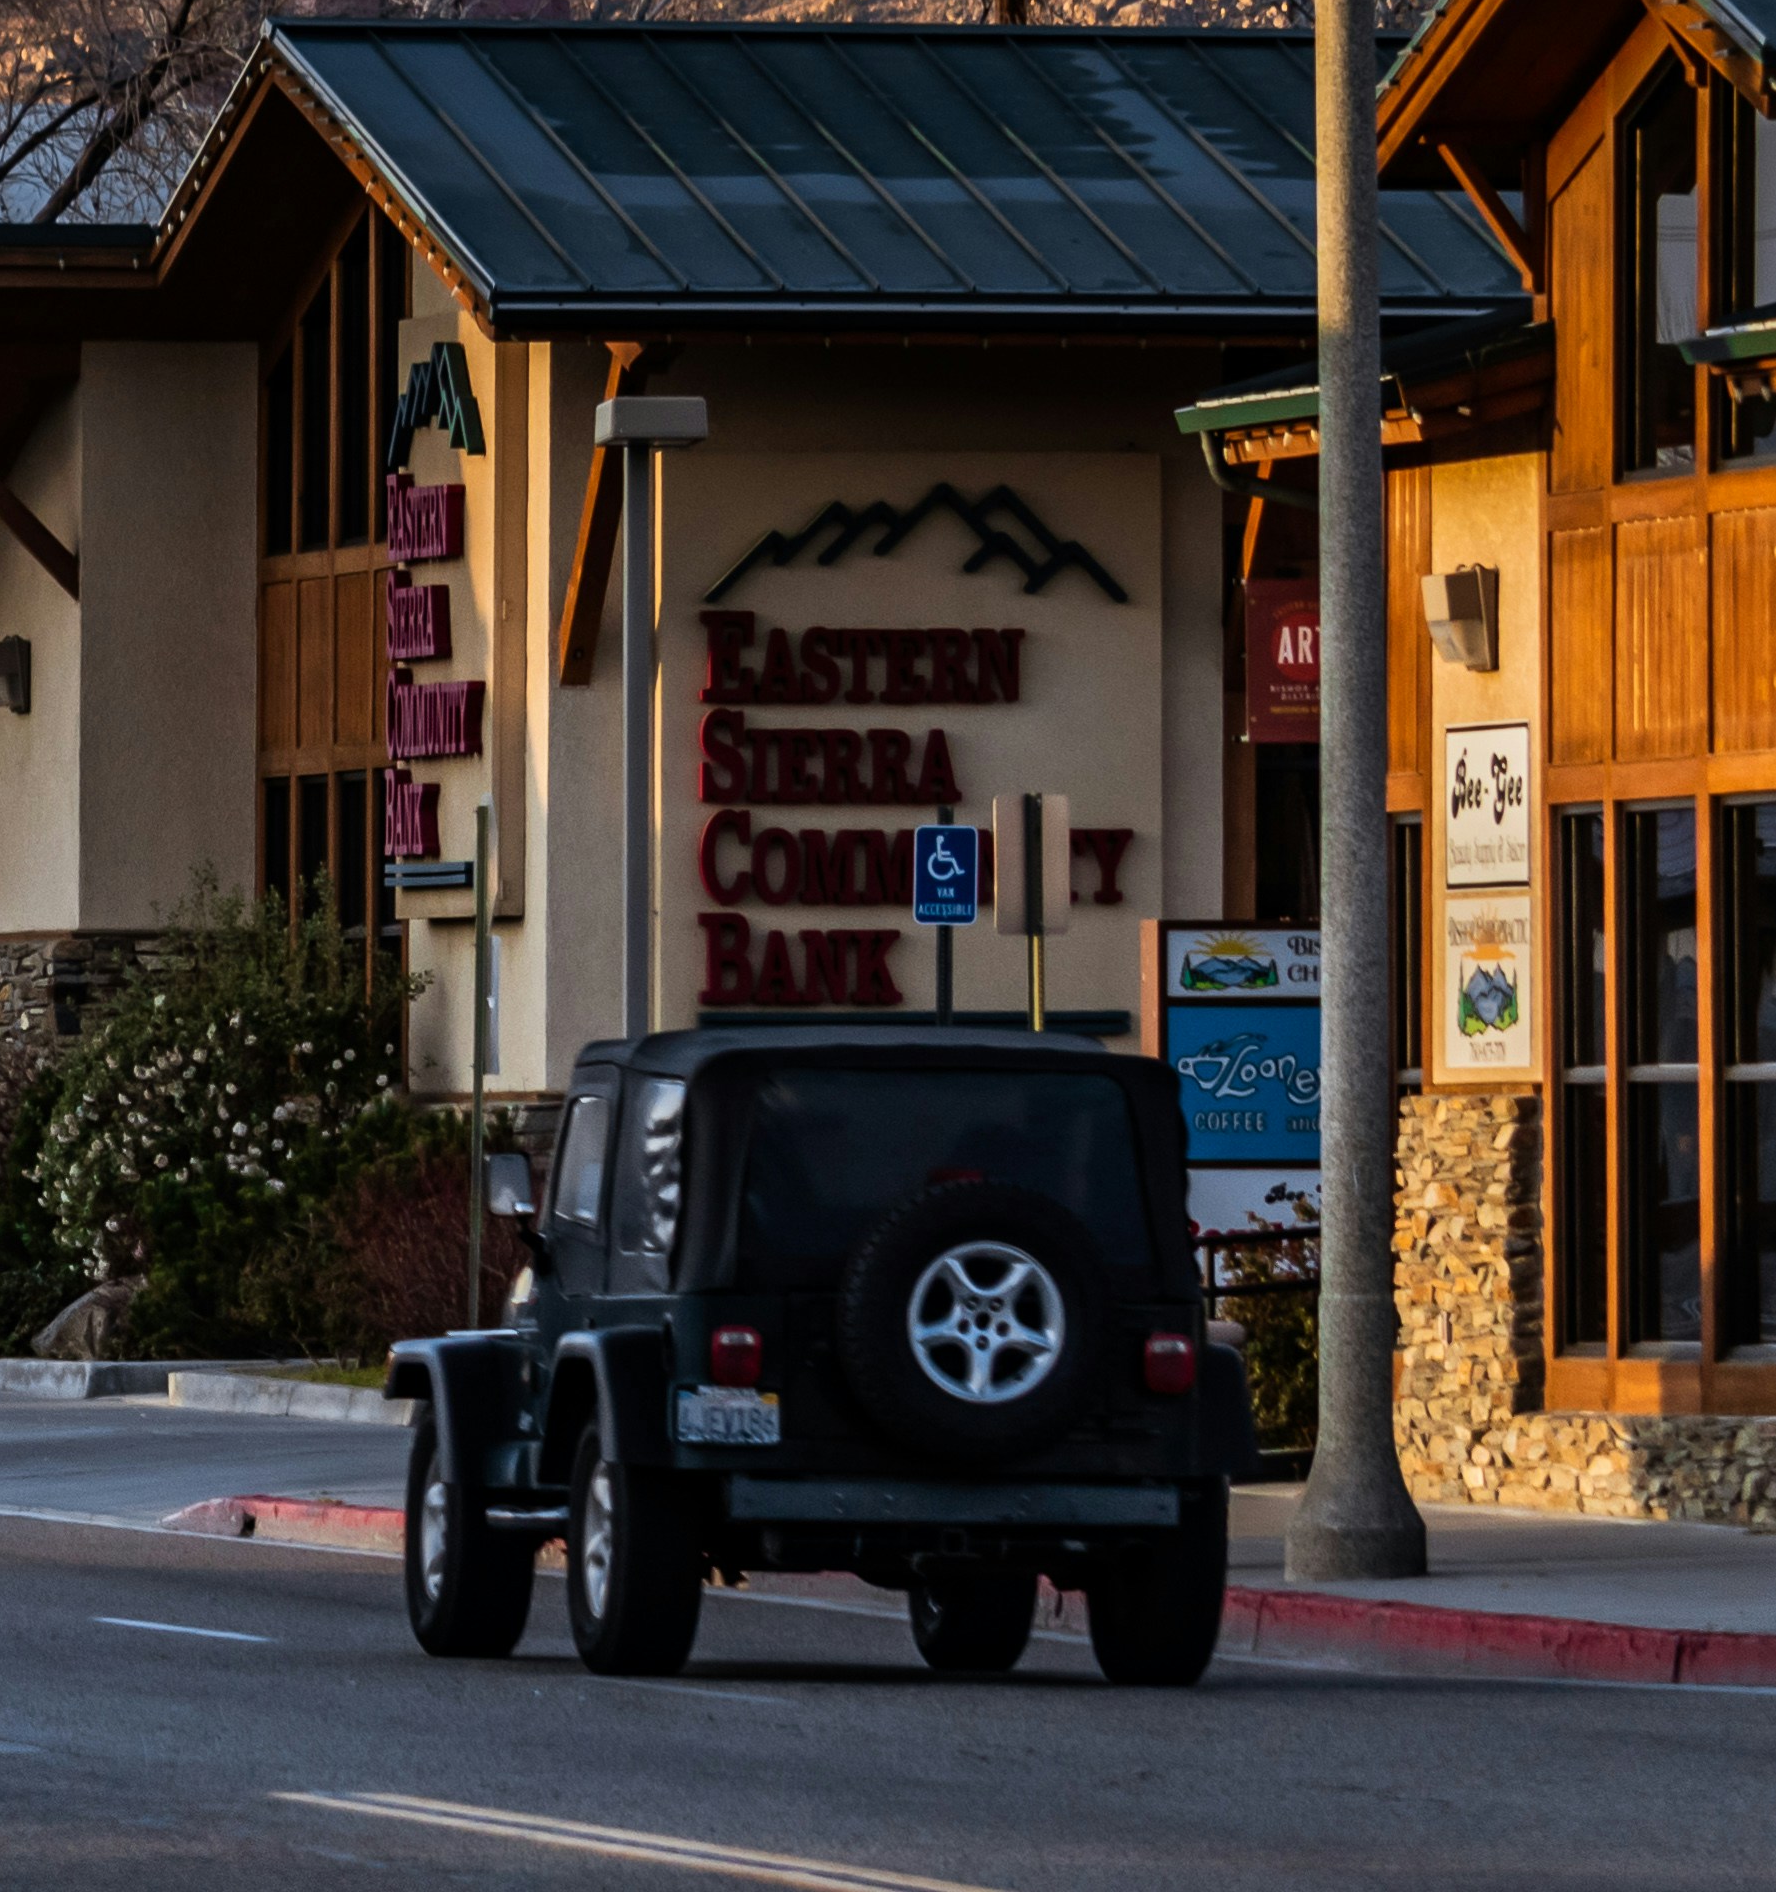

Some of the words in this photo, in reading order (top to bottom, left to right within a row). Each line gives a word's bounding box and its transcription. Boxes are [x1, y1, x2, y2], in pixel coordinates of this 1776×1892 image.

[386, 474, 452, 562] EASTERN
[385, 569, 438, 661] SIERRA
[698, 610, 1027, 706] EASTERN
[1277, 625, 1320, 665] AR
[385, 667, 470, 760] COMMUNITY
[698, 707, 963, 805] SIERRA
[385, 767, 426, 858] BANK
[698, 808, 1135, 907] COMMY
[917, 903, 973, 918] ACCESSIBLE
[936, 887, 956, 899] VAN
[697, 912, 904, 1006] BANK
[1193, 1111, 1265, 1132] COFFEE
